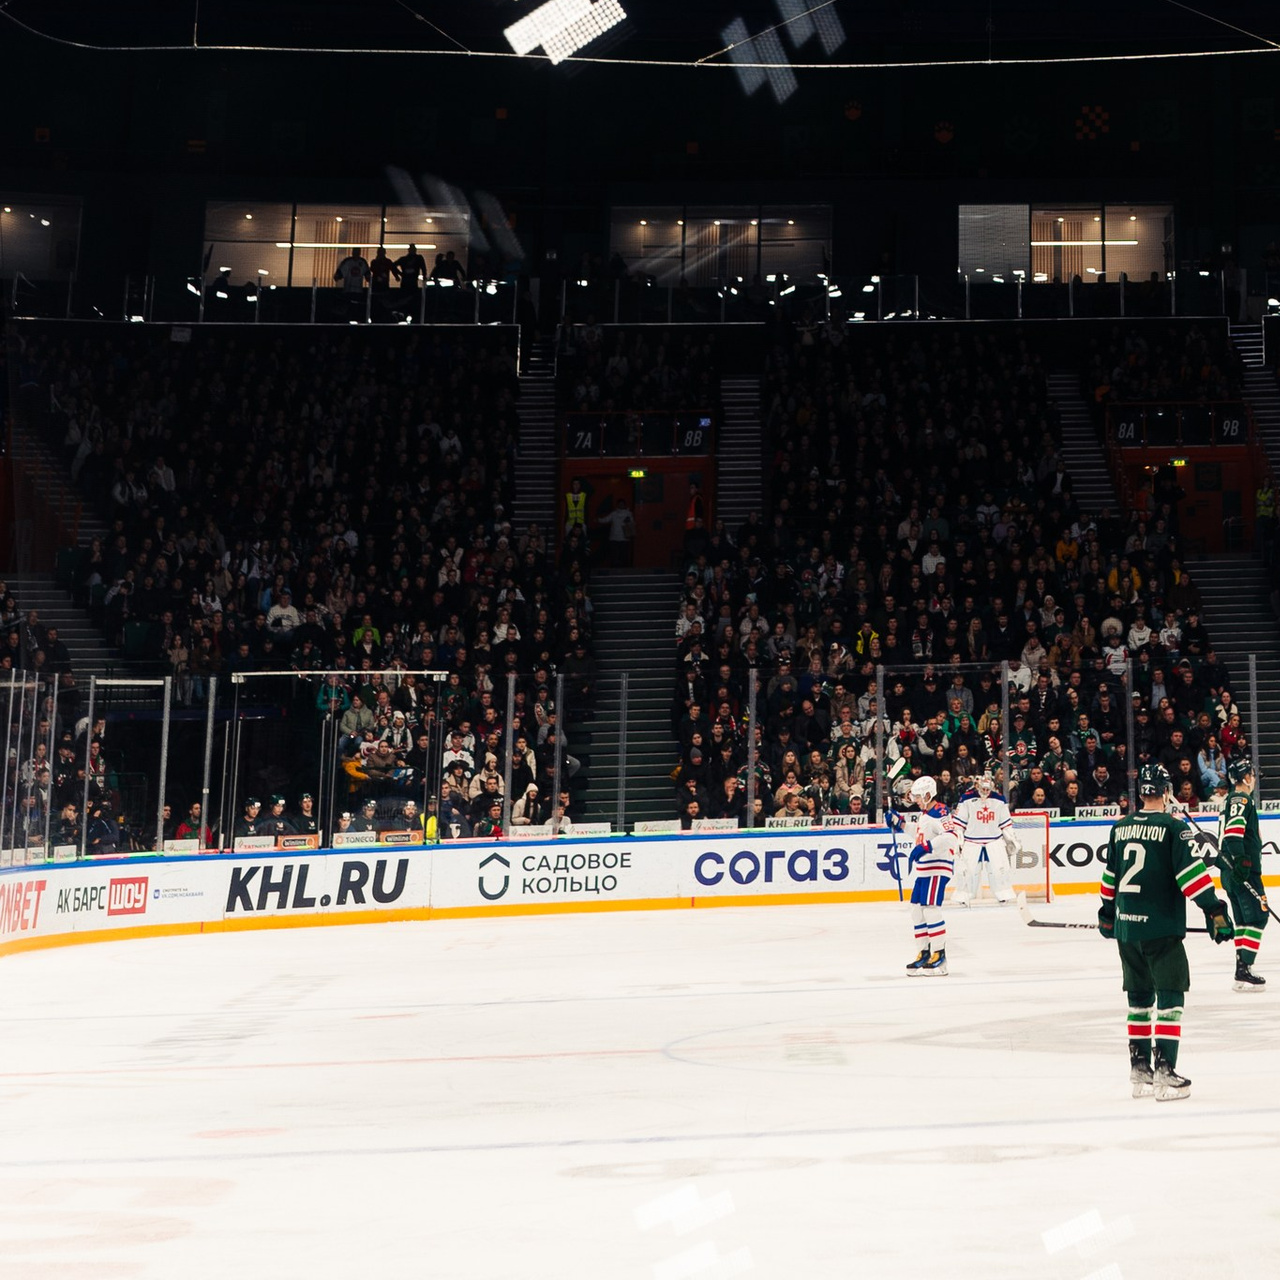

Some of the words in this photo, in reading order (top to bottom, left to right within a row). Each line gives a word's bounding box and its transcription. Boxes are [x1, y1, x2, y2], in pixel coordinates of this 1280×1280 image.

[1118, 422, 1135, 439] 8A
[1223, 420, 1239, 436] 9B
[575, 432, 592, 449] 7A
[684, 430, 702, 447] 8B
[1078, 808, 1118, 817] KHL.RU
[1230, 803, 1245, 817] 87
[825, 816, 866, 827] KHL.RU
[522, 852, 632, 874] САДОВОЕ
[1118, 842, 1147, 893] 2
[226, 858, 409, 913] KHL.RU
[522, 875, 618, 894] КОЛЬЦО
[56, 888, 70, 914] АК
[73, 886, 106, 912] БАРС
[110, 883, 146, 910] ШОУ
